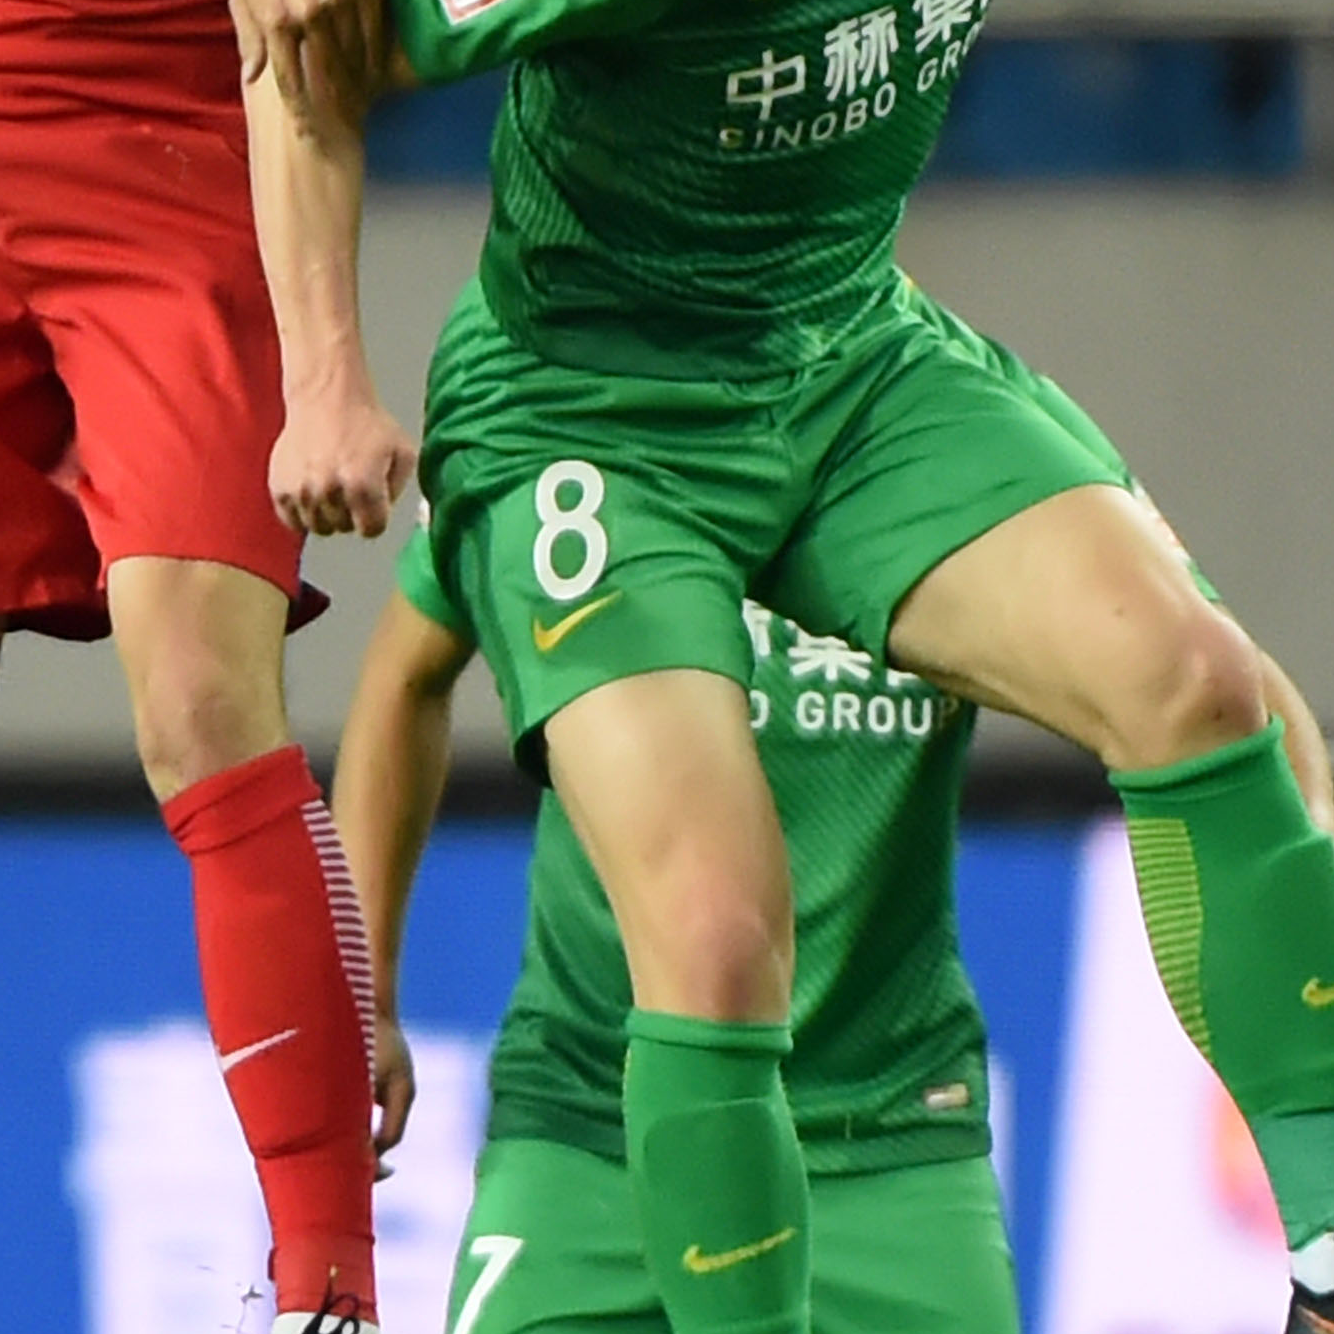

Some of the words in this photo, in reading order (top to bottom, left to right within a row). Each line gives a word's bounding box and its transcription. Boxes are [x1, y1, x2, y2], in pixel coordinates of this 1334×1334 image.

[719, 81, 897, 149] SINOBO
[532, 459, 608, 601] 8
[795, 690, 959, 736] GROUP
